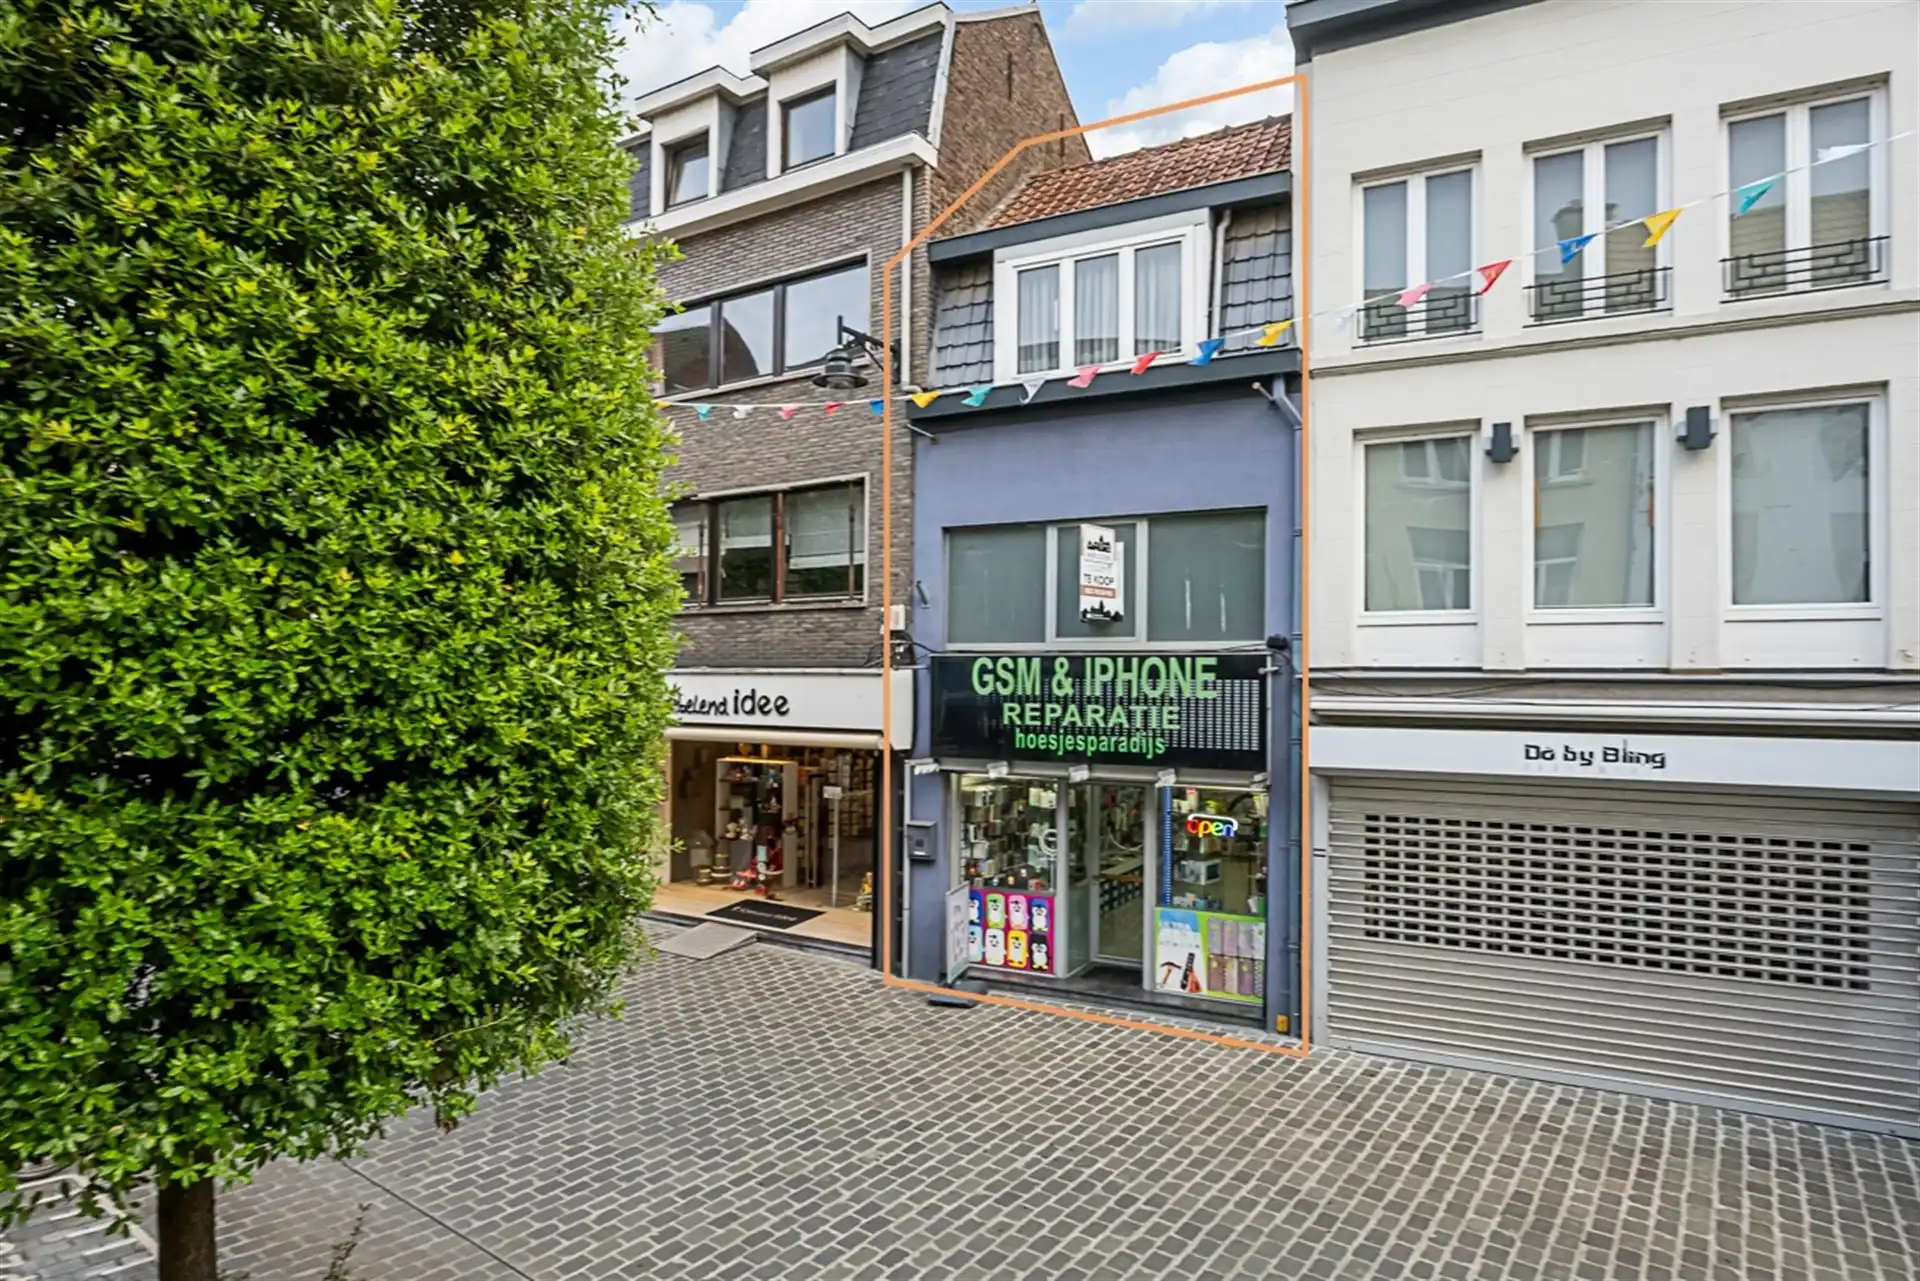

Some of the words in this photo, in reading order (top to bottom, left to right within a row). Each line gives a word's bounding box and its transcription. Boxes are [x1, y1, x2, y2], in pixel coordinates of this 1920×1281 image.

[971, 656, 1042, 696] GSM
[1051, 656, 1075, 698] &
[1085, 656, 1219, 700] IPHONE
[733, 688, 790, 717] idee
[1002, 702, 1181, 730] REPARATIE
[1014, 727, 1167, 760] hoesjesparadijs
[1563, 744, 1595, 767] by
[1602, 744, 1667, 770] Bling
